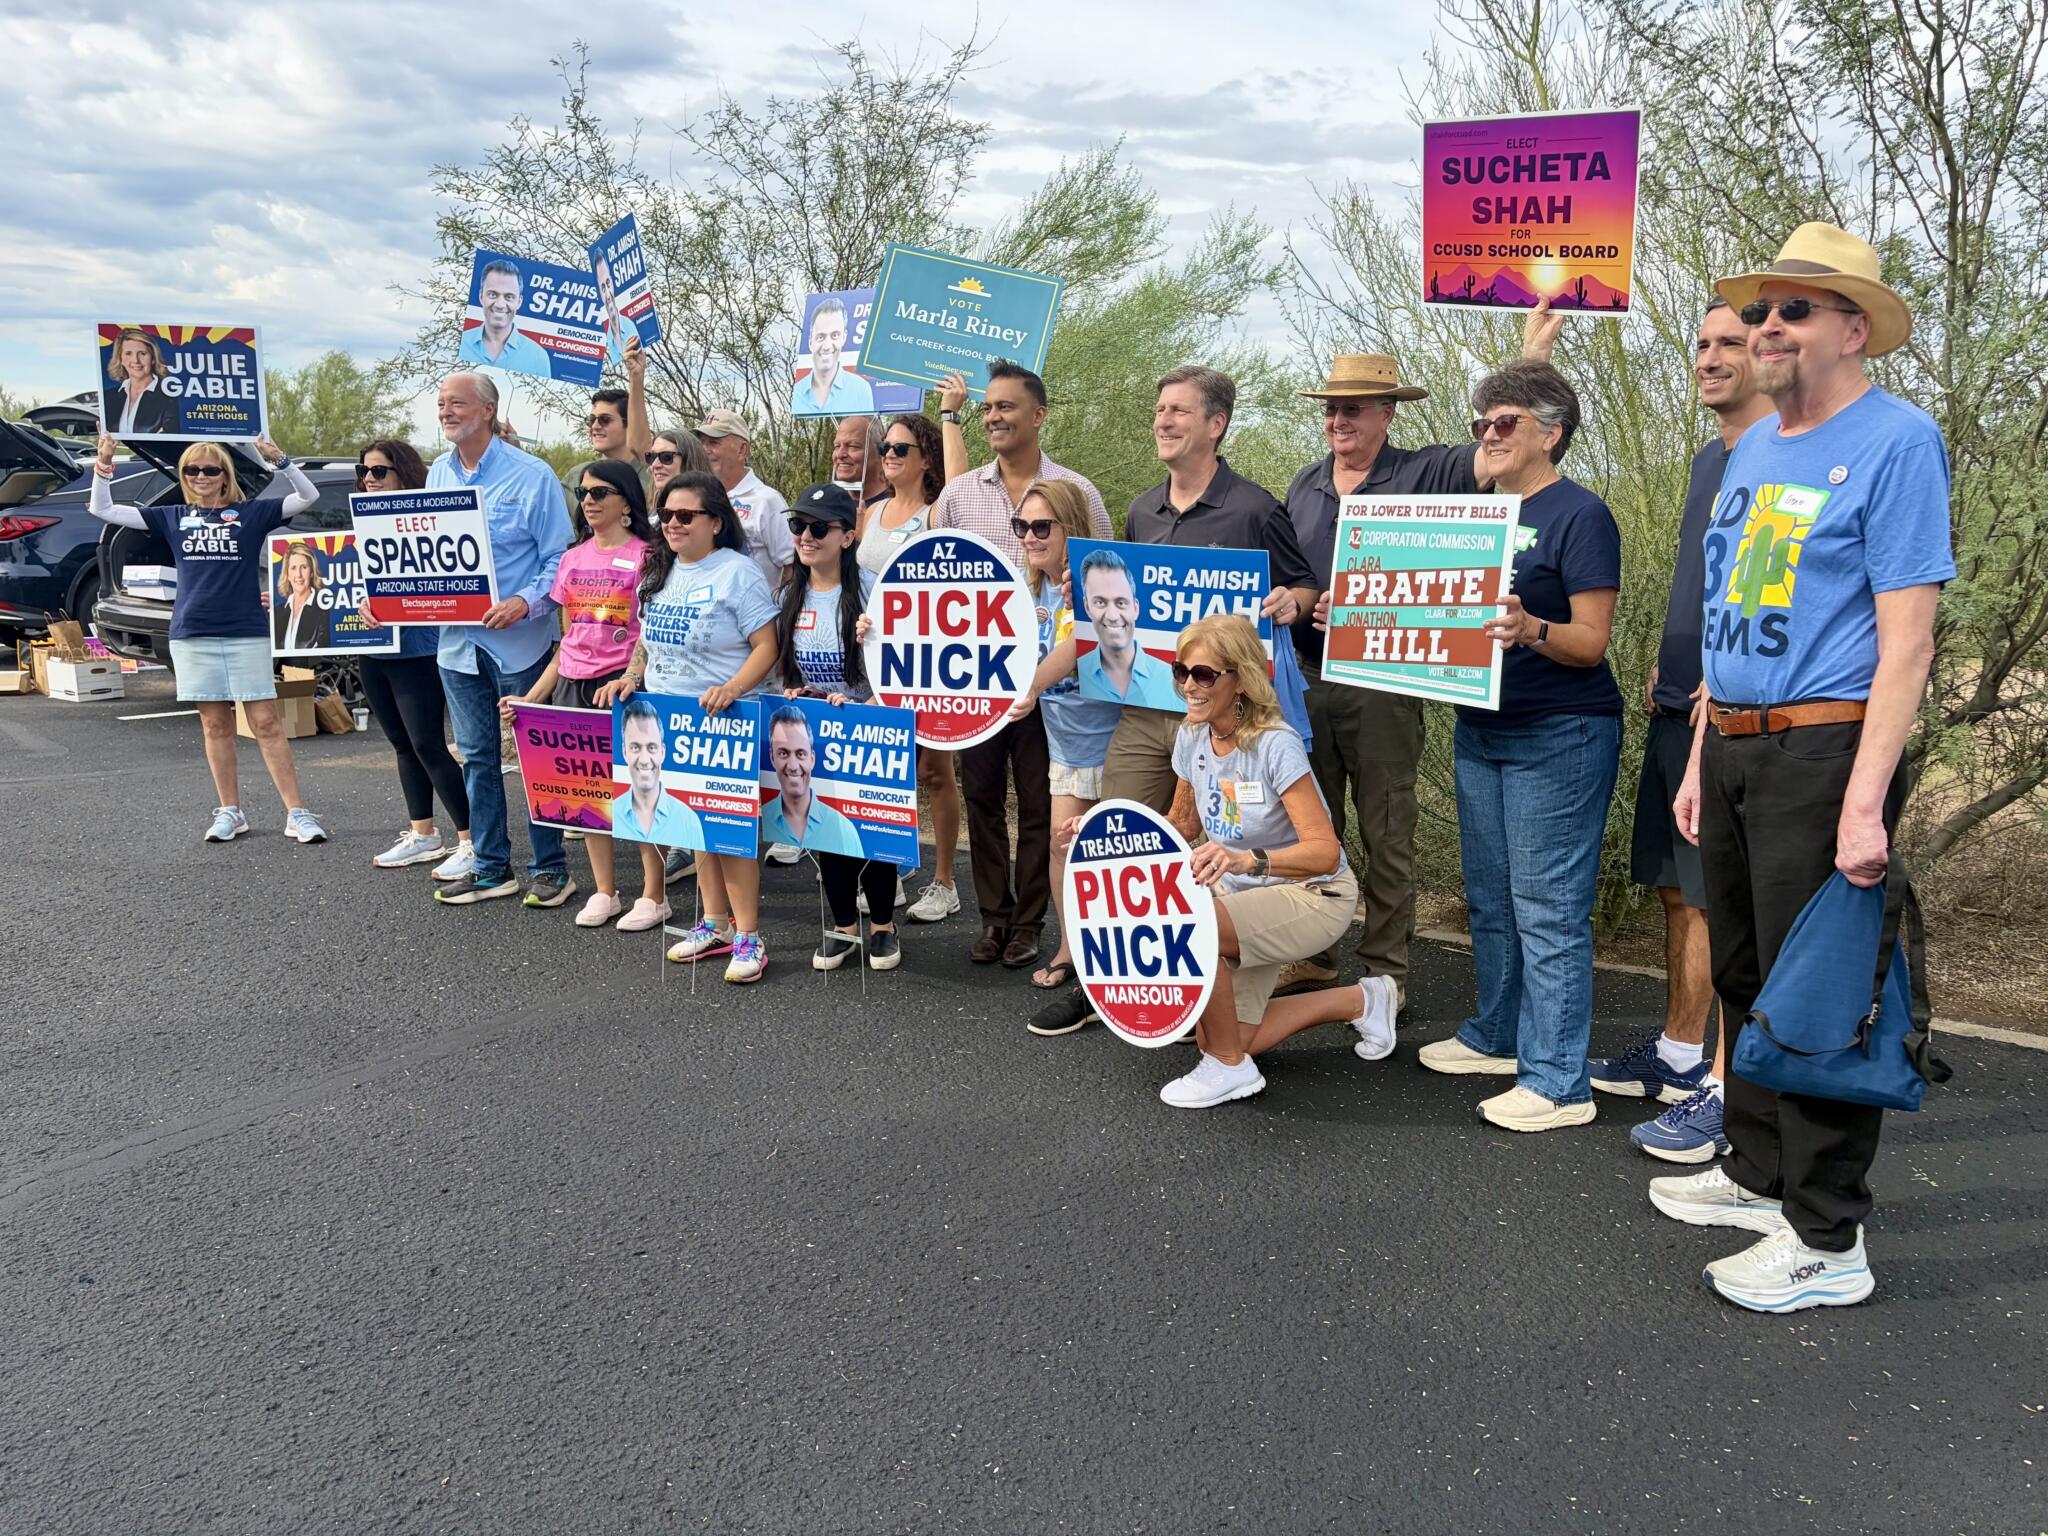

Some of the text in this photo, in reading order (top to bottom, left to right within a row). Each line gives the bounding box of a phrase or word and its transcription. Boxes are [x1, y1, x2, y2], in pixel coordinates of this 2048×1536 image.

[1506, 137, 1539, 150] ELECT
[1441, 151, 1611, 185] SUCHETA
[1472, 195, 1572, 225] SHAH
[617, 229, 636, 254] AMISH
[1510, 229, 1531, 239] FOR
[1433, 243, 1619, 259] CCUSD SCHOOL BOARD
[612, 247, 642, 288] SHAH
[529, 274, 598, 300] DR. AMIS
[529, 292, 606, 326] SHAH
[949, 298, 982, 312] VOTE
[557, 327, 602, 342] DEMOCRAT
[895, 300, 1028, 349] Marla Riney
[540, 337, 600, 356] U.S. CONGRESS
[890, 333, 1019, 366] CAVE CREEK SCHOOL BORD
[167, 352, 247, 376] JULIE
[161, 376, 256, 400] GABLE
[186, 411, 248, 421] STATE HOUSE
[196, 404, 238, 412] ARIZONA
[356, 496, 472, 512] COMMON SENSE & MODERATION
[1345, 505, 1508, 519] FOR LOWER UTILITY BILLS
[187, 528, 231, 541] JULIE
[395, 516, 437, 533] ELECT
[181, 540, 239, 553] GABLE
[1348, 529, 1361, 546] AZ
[1363, 531, 1427, 548] CORPORATION
[1428, 533, 1496, 551] COMMISSION
[364, 533, 480, 575] SPARGO
[932, 542, 957, 560] AZ
[322, 562, 364, 586] JUL
[897, 561, 995, 580] TREASURER
[1346, 556, 1382, 572] CLARA
[1704, 533, 1727, 602] 3
[376, 579, 479, 593] ARIZONA STATE HOUSE
[570, 577, 625, 588] SUCHETA
[1142, 565, 1260, 591] DR. AMISH
[1345, 569, 1485, 605] PRATTE
[317, 586, 366, 610] GAB
[577, 588, 611, 598] SHAH
[401, 599, 457, 609] Electspargo.com
[647, 602, 701, 619] CLIMATE
[883, 590, 1016, 637] PICK
[1149, 589, 1262, 629] SHAH
[1424, 609, 1482, 619] CLARAFORAZ.COM
[335, 623, 357, 632] STATE
[343, 615, 364, 623] ARIZO
[1343, 611, 1398, 628] JONATHON
[645, 628, 686, 646] UNITE!
[1704, 608, 1789, 658] EMS
[1363, 629, 1449, 663] HILL
[880, 643, 1018, 692] NICK
[1428, 667, 1483, 680] VOTEHILLAZ.COM
[900, 695, 992, 716] MANSOUR
[569, 723, 593, 731] ELECT
[669, 713, 755, 738] DR. AMISH
[819, 720, 847, 740] DR.
[850, 723, 910, 747] AMISH
[528, 728, 612, 754] SUCHE
[672, 735, 754, 771] SHAH
[822, 742, 910, 781] SHAH
[532, 782, 613, 800] CCUSD SCHOO
[585, 779, 600, 787] FOR
[705, 780, 754, 795] DEMOCRAT
[689, 796, 753, 813] U.S. CONGRESS
[859, 789, 911, 805] DEMOCRAT
[1207, 792, 1221, 817] 3
[842, 803, 912, 823] U.S. CONGRESS
[860, 823, 913, 837] AmishForArizona.com
[1105, 814, 1127, 834] AZ
[1204, 816, 1243, 840] DEMS
[1080, 831, 1163, 858] TREASURER
[1073, 861, 1193, 920] PICK
[1080, 923, 1204, 977] NICK
[1104, 986, 1185, 1006] MANSOUR
[1789, 1261, 1826, 1284] HOKA
